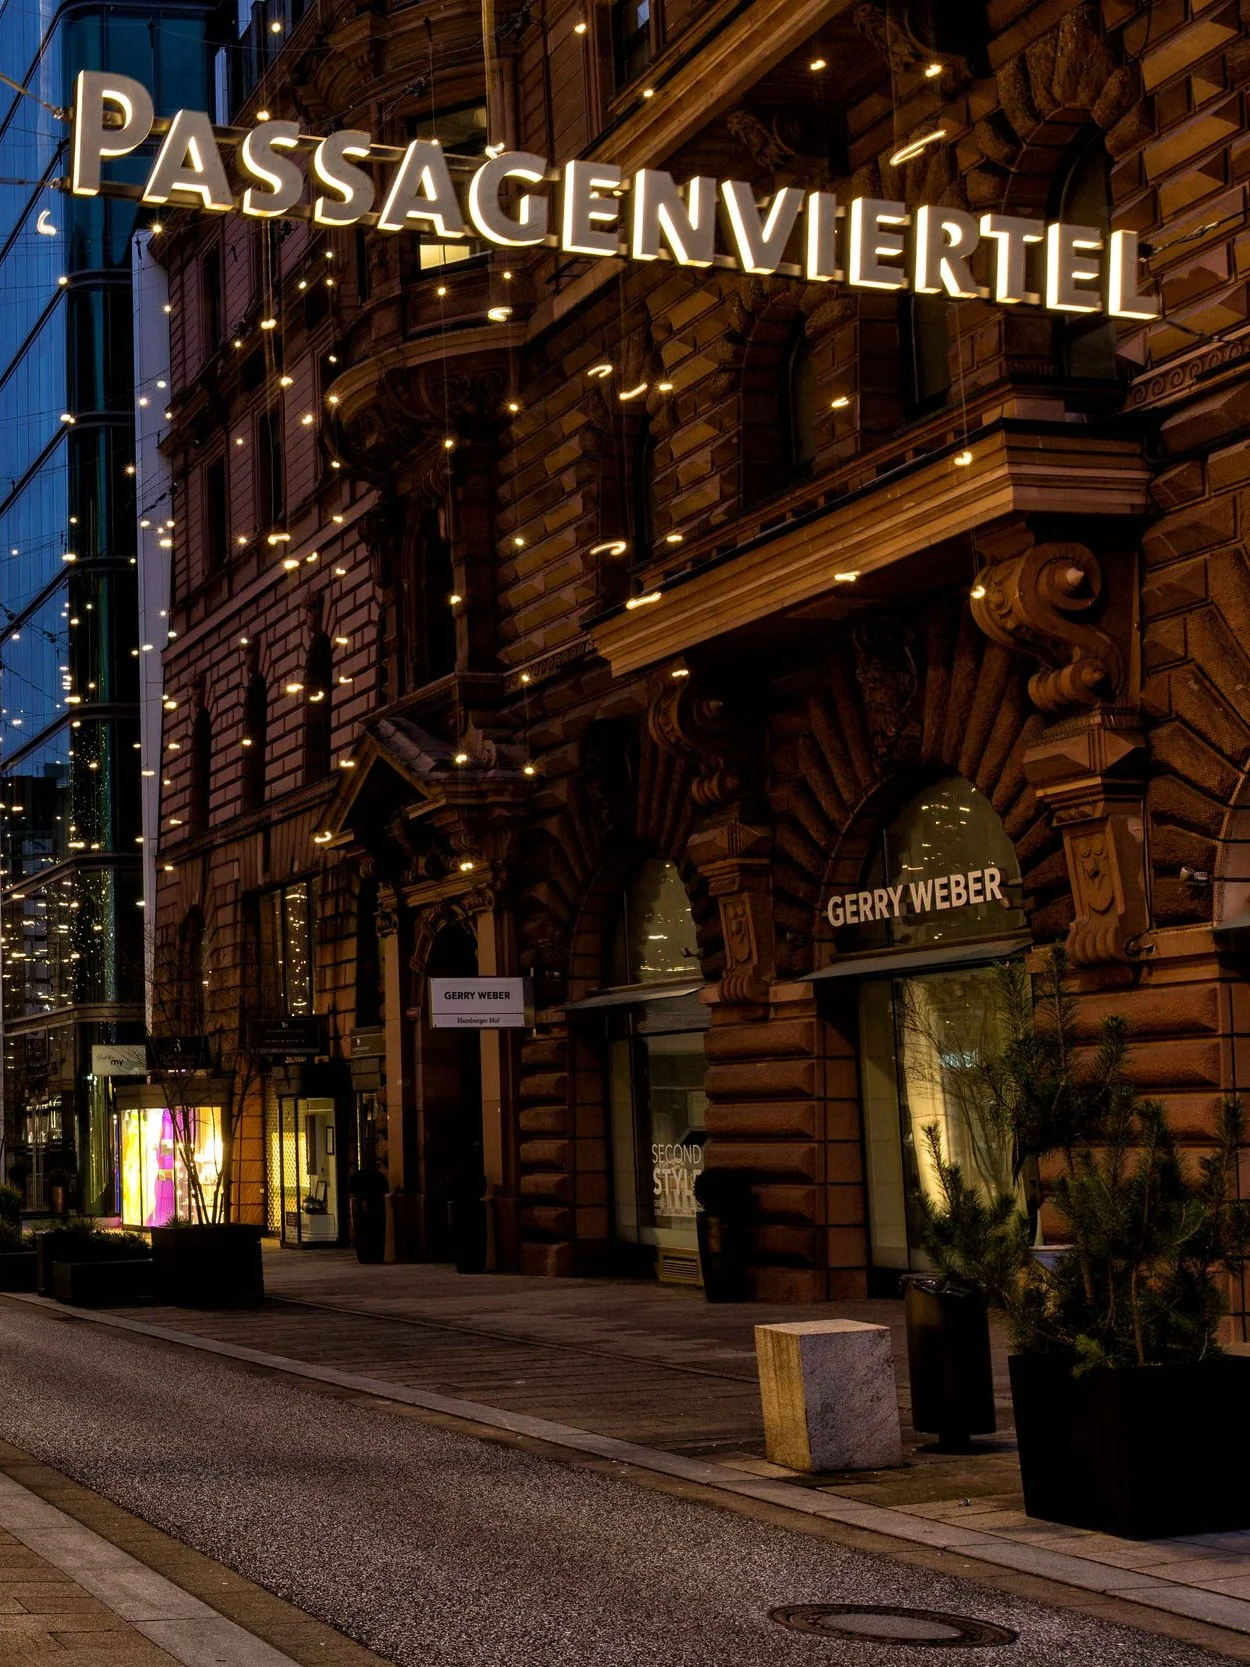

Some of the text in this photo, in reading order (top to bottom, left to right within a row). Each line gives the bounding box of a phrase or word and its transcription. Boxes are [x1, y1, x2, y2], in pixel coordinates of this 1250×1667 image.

[72, 69, 1161, 320] PASSAGENVIERTEL
[827, 867, 1003, 927] GERRY WEBER
[444, 991, 511, 1000] GERRY WEBER
[457, 1017, 488, 1025] Hamburger
[651, 1144, 702, 1164] SECOND
